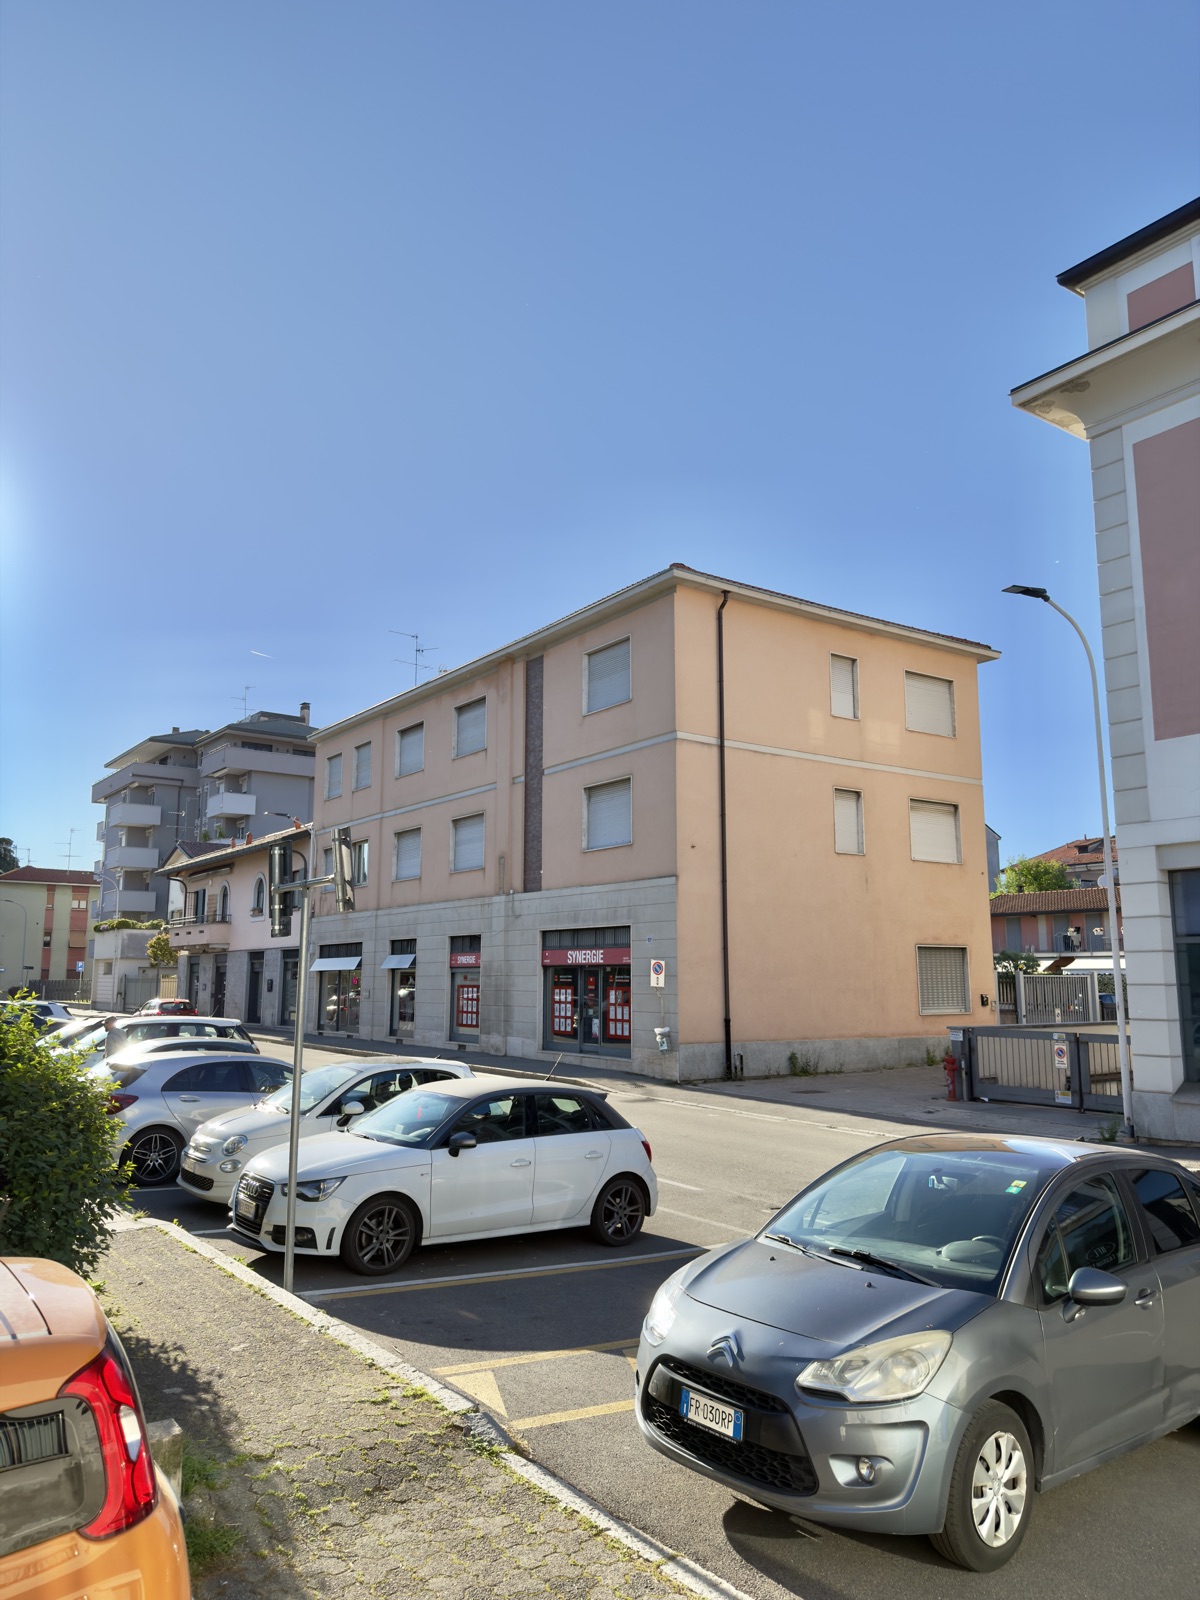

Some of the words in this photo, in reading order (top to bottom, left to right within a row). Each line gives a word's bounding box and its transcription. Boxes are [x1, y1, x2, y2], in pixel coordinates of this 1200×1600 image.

[567, 950, 604, 964] SYNERGIE
[689, 1397, 700, 1417] FR
[702, 1403, 733, 1429] 030RP
